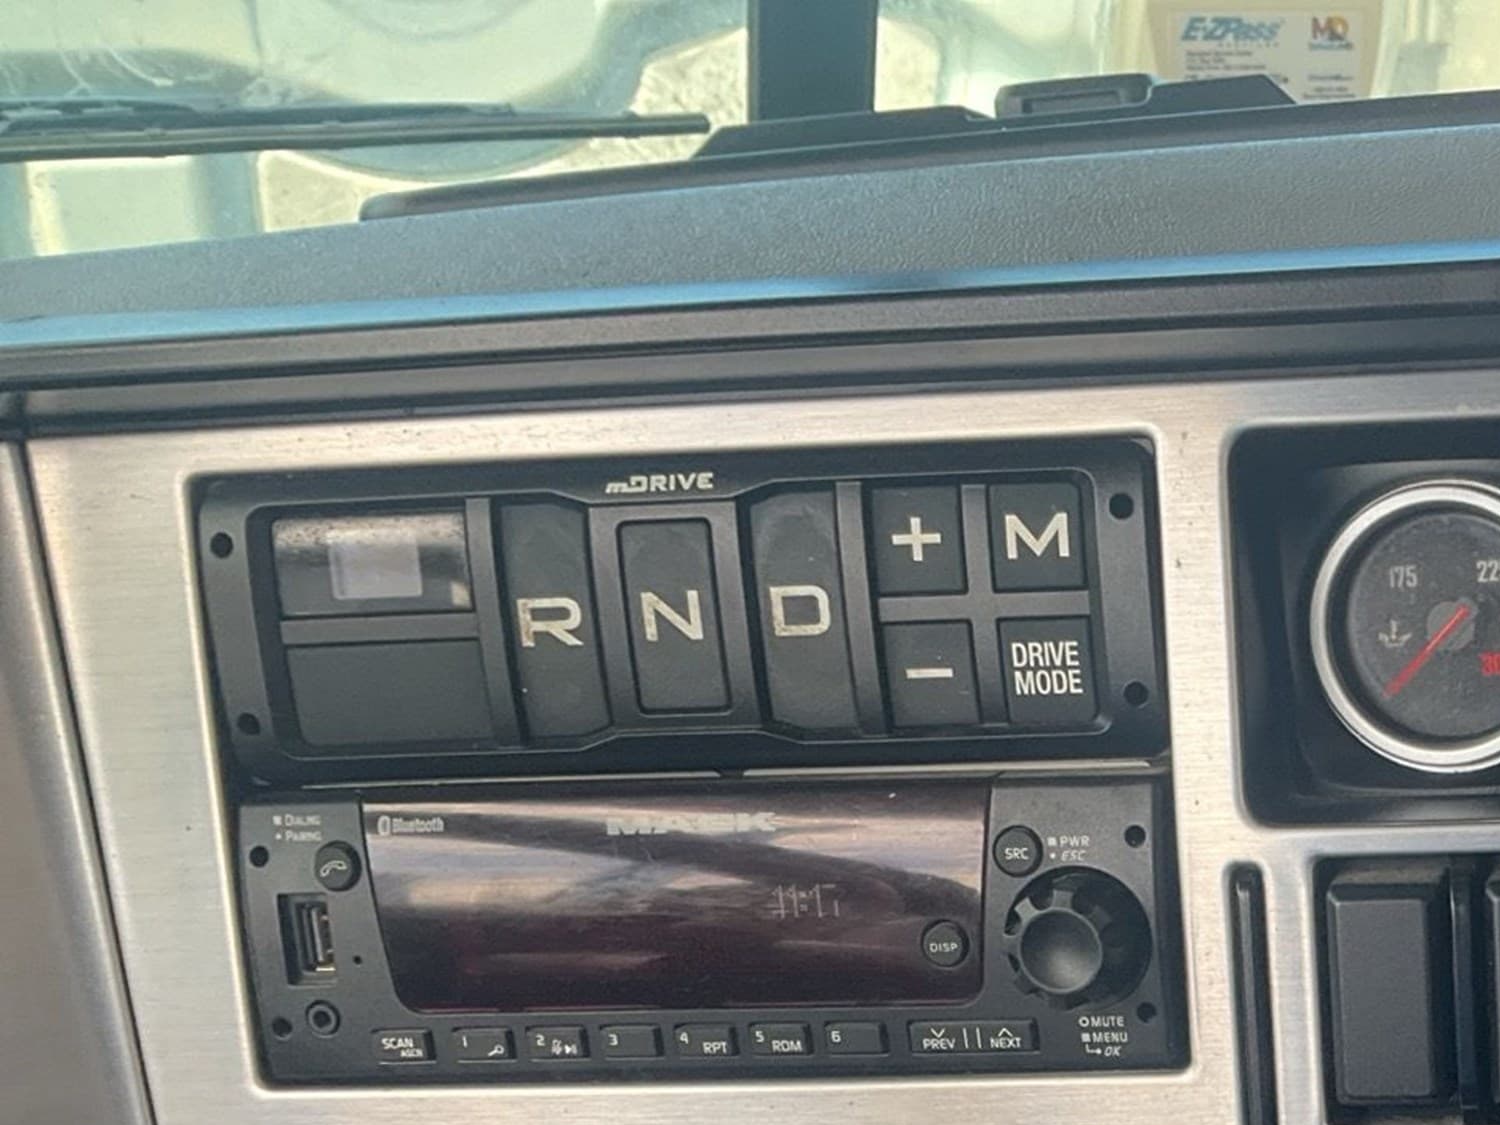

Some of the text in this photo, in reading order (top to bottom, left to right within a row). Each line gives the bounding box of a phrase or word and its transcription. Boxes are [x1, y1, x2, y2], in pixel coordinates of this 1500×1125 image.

[1004, 512, 1070, 560] M
[1389, 566, 1418, 588] 175
[640, 588, 704, 642] N
[769, 584, 831, 637] D
[516, 596, 584, 647] R
[1012, 640, 1080, 669] DRIVE
[1014, 669, 1084, 696] MODE
[1060, 835, 1090, 848] PWR
[1005, 847, 1029, 860] SRC
[1061, 850, 1087, 862] ESC
[929, 941, 959, 954] DISP
[1091, 1017, 1124, 1027] MUTE
[461, 1035, 468, 1048] 1
[535, 1035, 545, 1046] 2
[609, 1034, 618, 1045] 3
[679, 1032, 689, 1044] 4
[755, 1031, 764, 1042] 5
[831, 1030, 841, 1042] 6
[1092, 1032, 1128, 1043] MENU
[381, 1037, 414, 1049] SCAN
[703, 1041, 727, 1054] RPT
[923, 1038, 956, 1050] PREV
[990, 1037, 1021, 1049] NEXT
[1104, 1046, 1121, 1056] OK
